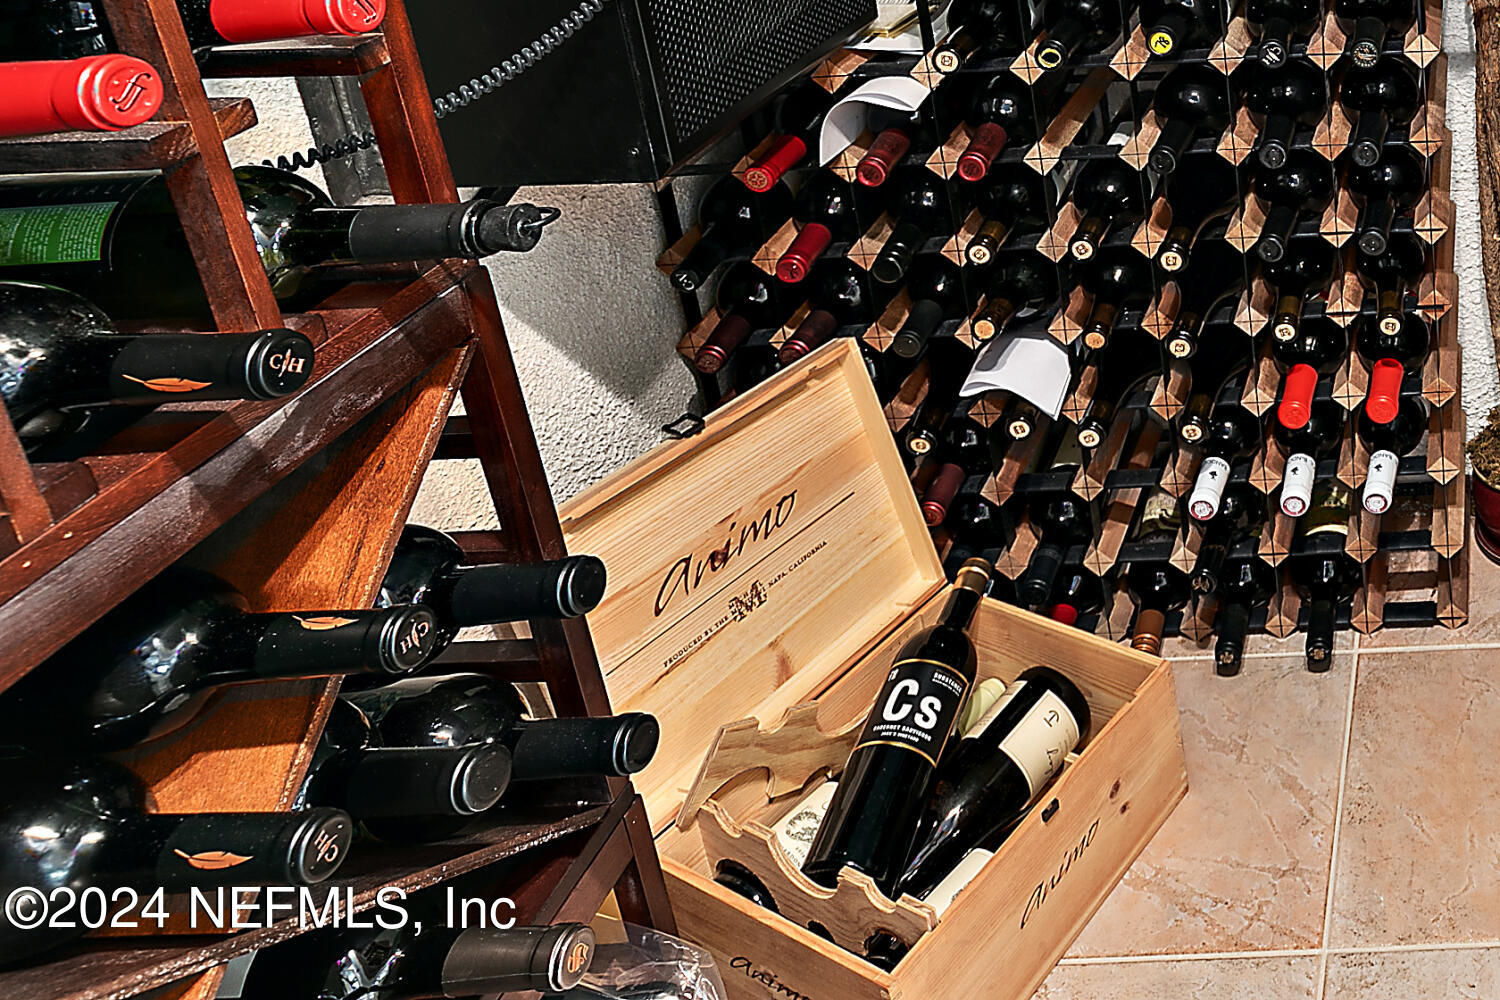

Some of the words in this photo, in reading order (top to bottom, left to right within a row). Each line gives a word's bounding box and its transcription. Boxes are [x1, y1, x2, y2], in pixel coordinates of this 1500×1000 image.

[788, 539, 828, 572] CALIFORNIA
[663, 634, 703, 668] PRODUCED
[714, 614, 730, 629] THE
[882, 678, 942, 730] Cs
